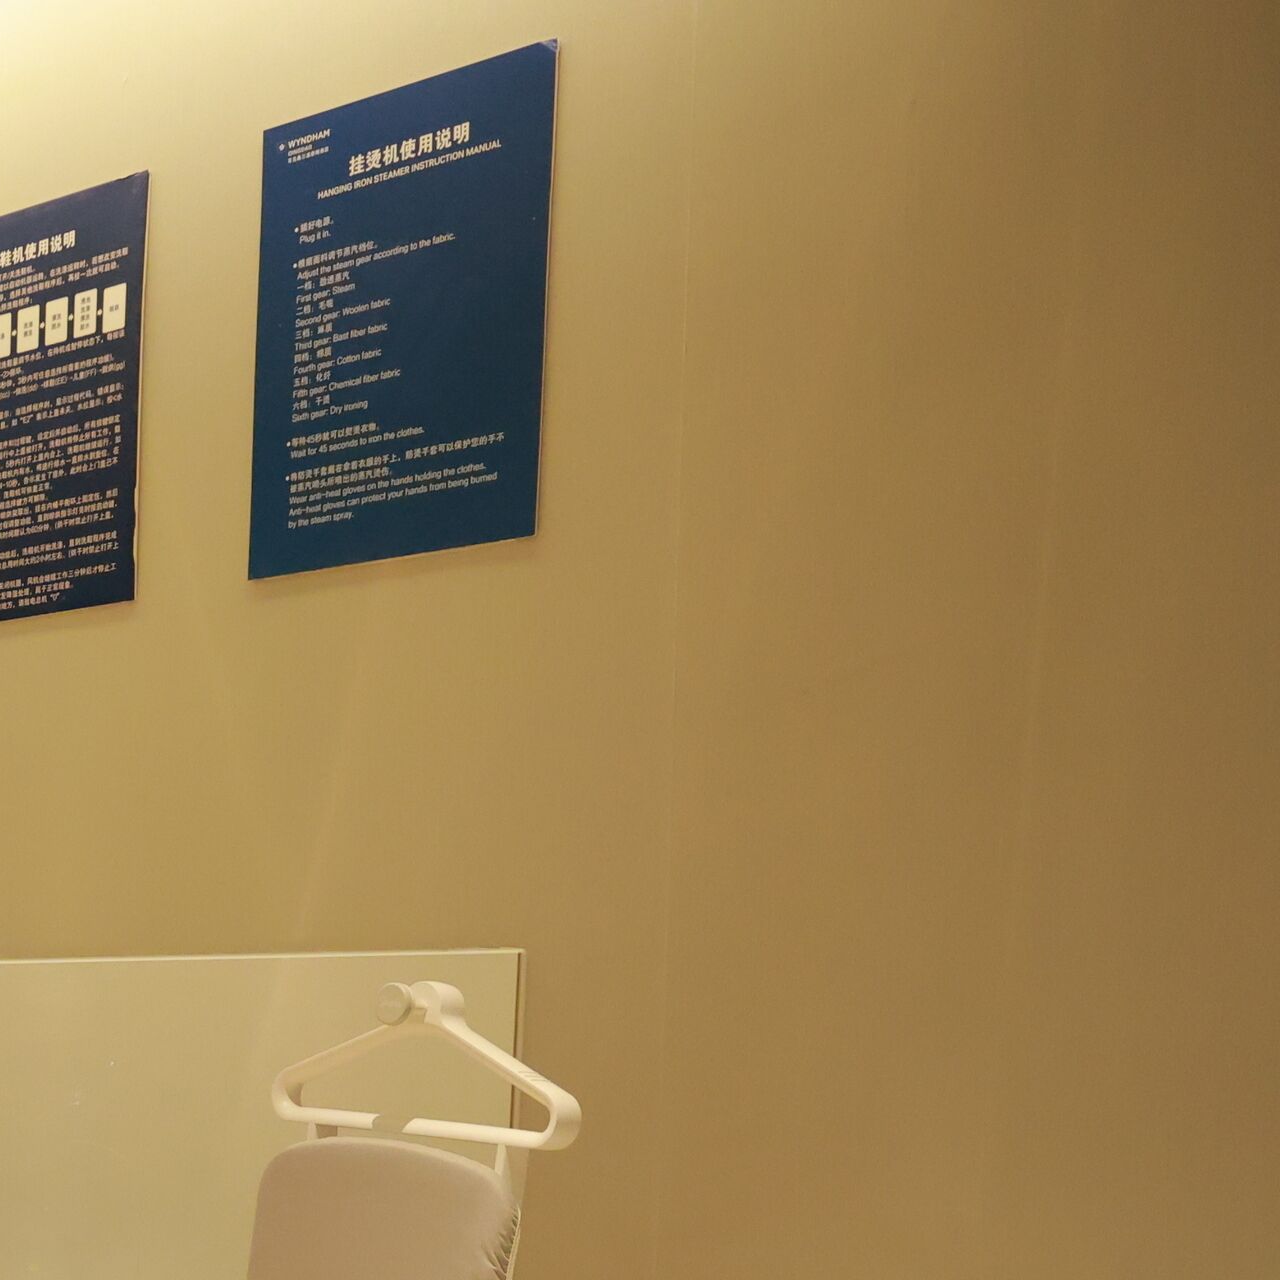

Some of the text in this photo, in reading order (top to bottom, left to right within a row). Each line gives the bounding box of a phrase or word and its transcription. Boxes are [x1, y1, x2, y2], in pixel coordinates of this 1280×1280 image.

[288, 128, 330, 148] WYNDHAM
[348, 121, 469, 176] 挂烫机使用说明
[317, 139, 501, 199] HANGING IRON STEAMER INSTRUCTION MANUAL
[299, 234, 315, 244] Plug
[316, 231, 321, 239] it
[297, 233, 455, 279] Adjust the steam gear according to the fabric.
[296, 293, 311, 304] First
[332, 283, 355, 295] Steam
[295, 314, 321, 327] Second
[342, 303, 369, 316] Woolen
[370, 298, 390, 309] fabric
[295, 339, 312, 350] Third
[332, 331, 349, 342] Bast
[367, 323, 387, 333] fabric
[293, 363, 316, 374] Fourth
[336, 354, 360, 365] Cotton
[361, 349, 381, 359] fabric
[292, 388, 307, 398] Fifth
[328, 376, 361, 390] Chemical
[362, 373, 378, 383] fiber
[380, 368, 400, 379] fabric
[292, 412, 309, 422] Sixth
[330, 405, 342, 414] Dry
[343, 400, 368, 411] ironing
[290, 449, 306, 458] Wait
[307, 447, 317, 455] for
[318, 443, 327, 452] 45
[328, 439, 358, 451] seconds
[359, 437, 367, 445] to
[368, 435, 382, 443] iron
[383, 432, 395, 440] the
[289, 495, 307, 504] Wear
[308, 488, 341, 501] anti-heat
[342, 484, 365, 496] gloves
[377, 479, 389, 488] the
[390, 475, 413, 485] hands
[414, 470, 441, 481] holding
[443, 468, 455, 476] the
[456, 462, 486, 474] clothes.
[322, 500, 345, 512] gloves
[346, 497, 359, 506] can
[361, 492, 385, 504] protect
[387, 489, 403, 500] your
[405, 484, 427, 496] hands
[429, 482, 446, 491] from
[447, 478, 468, 488] being
[470, 471, 497, 484] burned
[288, 521, 296, 529] by
[310, 515, 331, 524] steam
